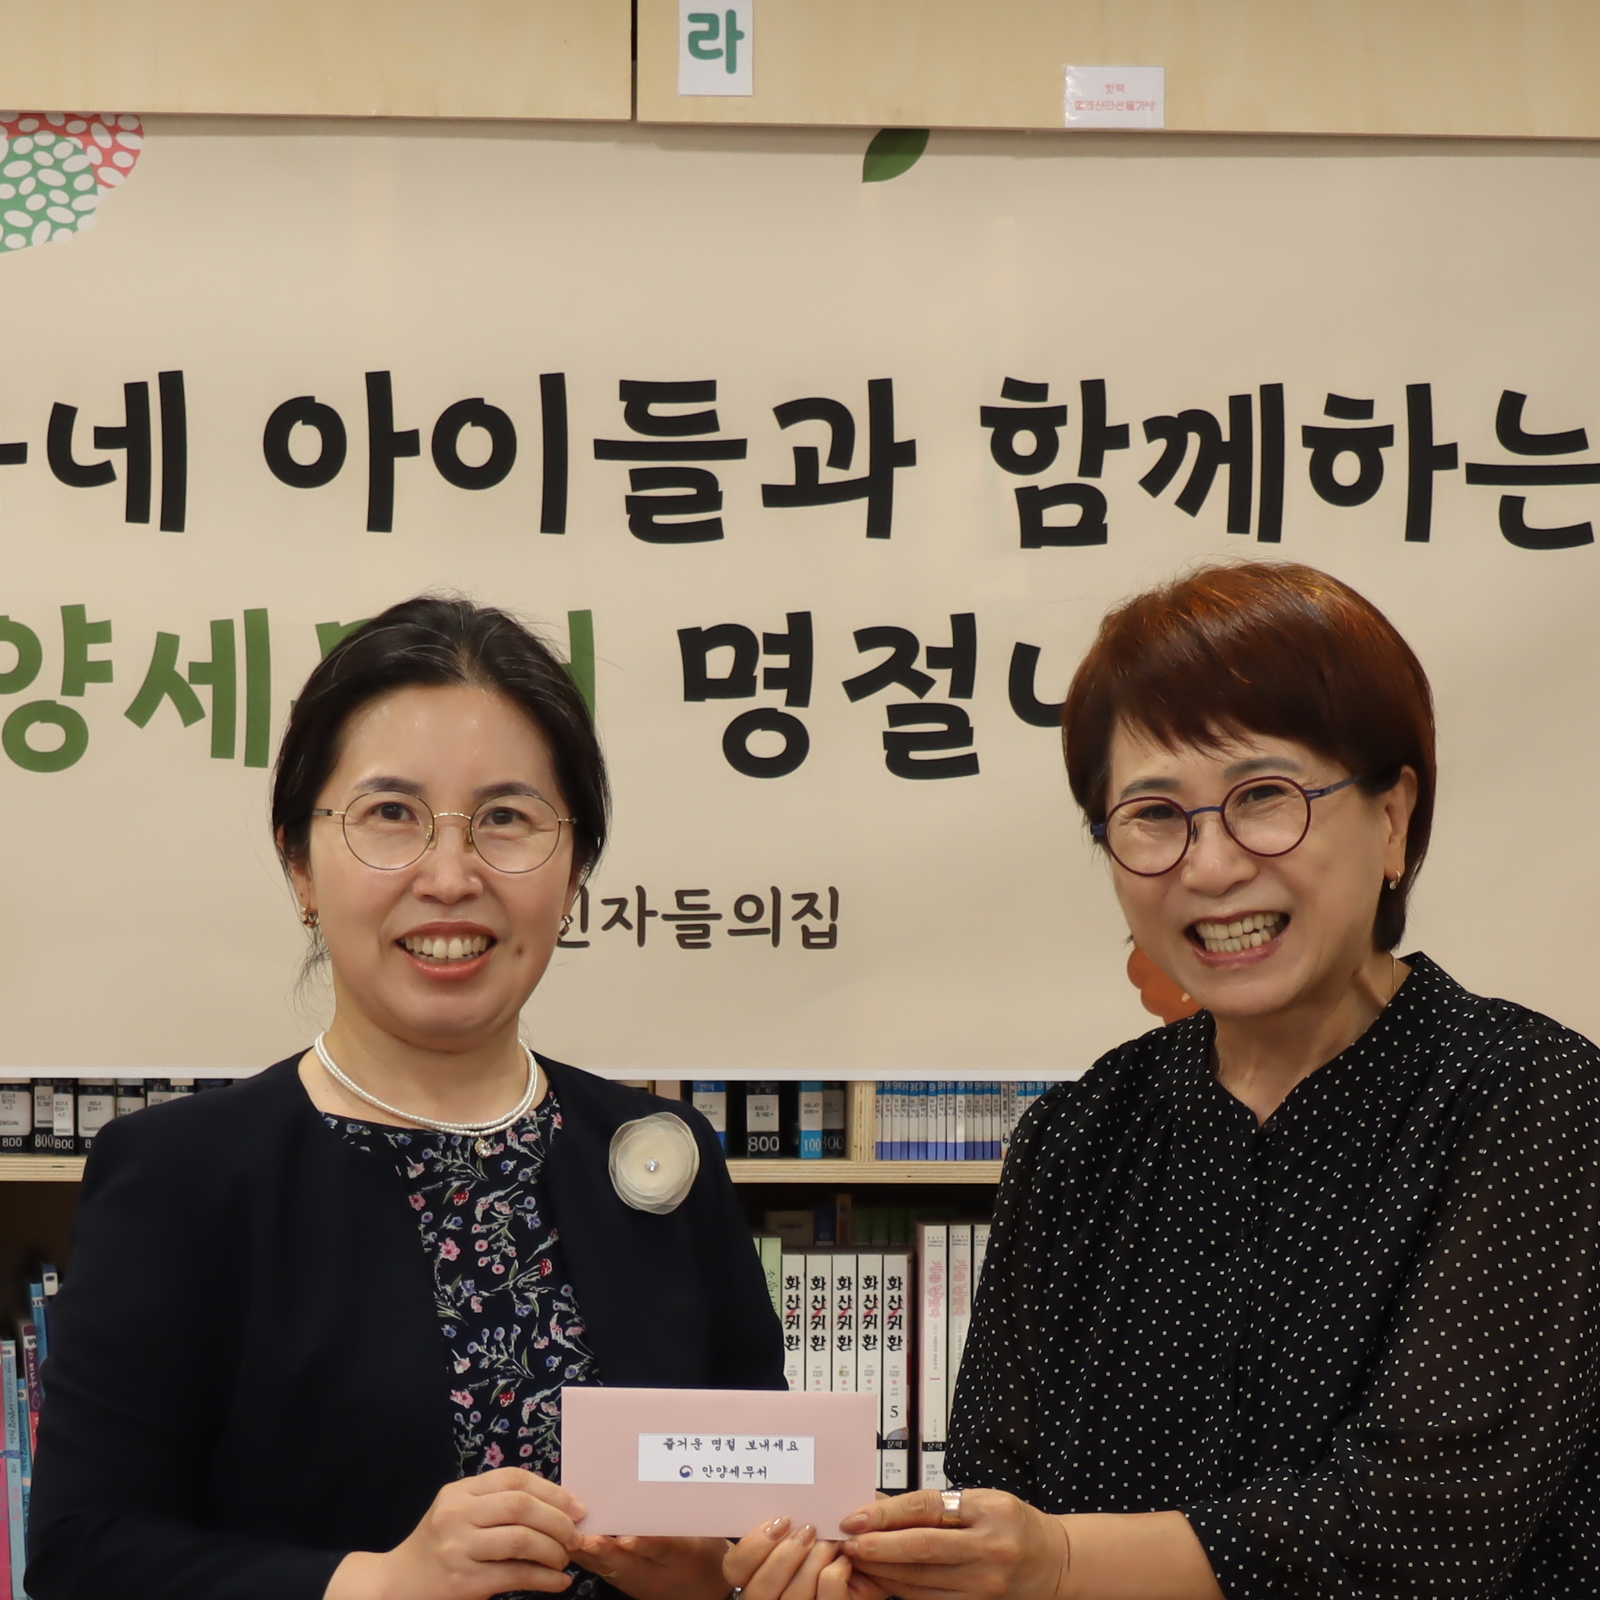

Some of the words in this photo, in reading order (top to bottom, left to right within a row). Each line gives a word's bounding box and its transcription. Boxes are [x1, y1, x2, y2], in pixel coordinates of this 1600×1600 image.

[687, 9, 745, 74] 라
[263, 369, 917, 545] 아이들과
[747, 1136, 780, 1152] 800
[784, 1275, 801, 1352] 화산귀환
[810, 1275, 827, 1352] 화산귀환
[836, 1275, 853, 1352] 화산귀환
[861, 1275, 879, 1352] 화산귀환
[887, 1275, 904, 1352] 화산귀환
[662, 1437, 703, 1451] 즐거운
[711, 1438, 737, 1452] 명절
[745, 1438, 799, 1452] 보내세요
[890, 1405, 899, 1418] 5
[702, 1465, 768, 1480] 안양세무서
